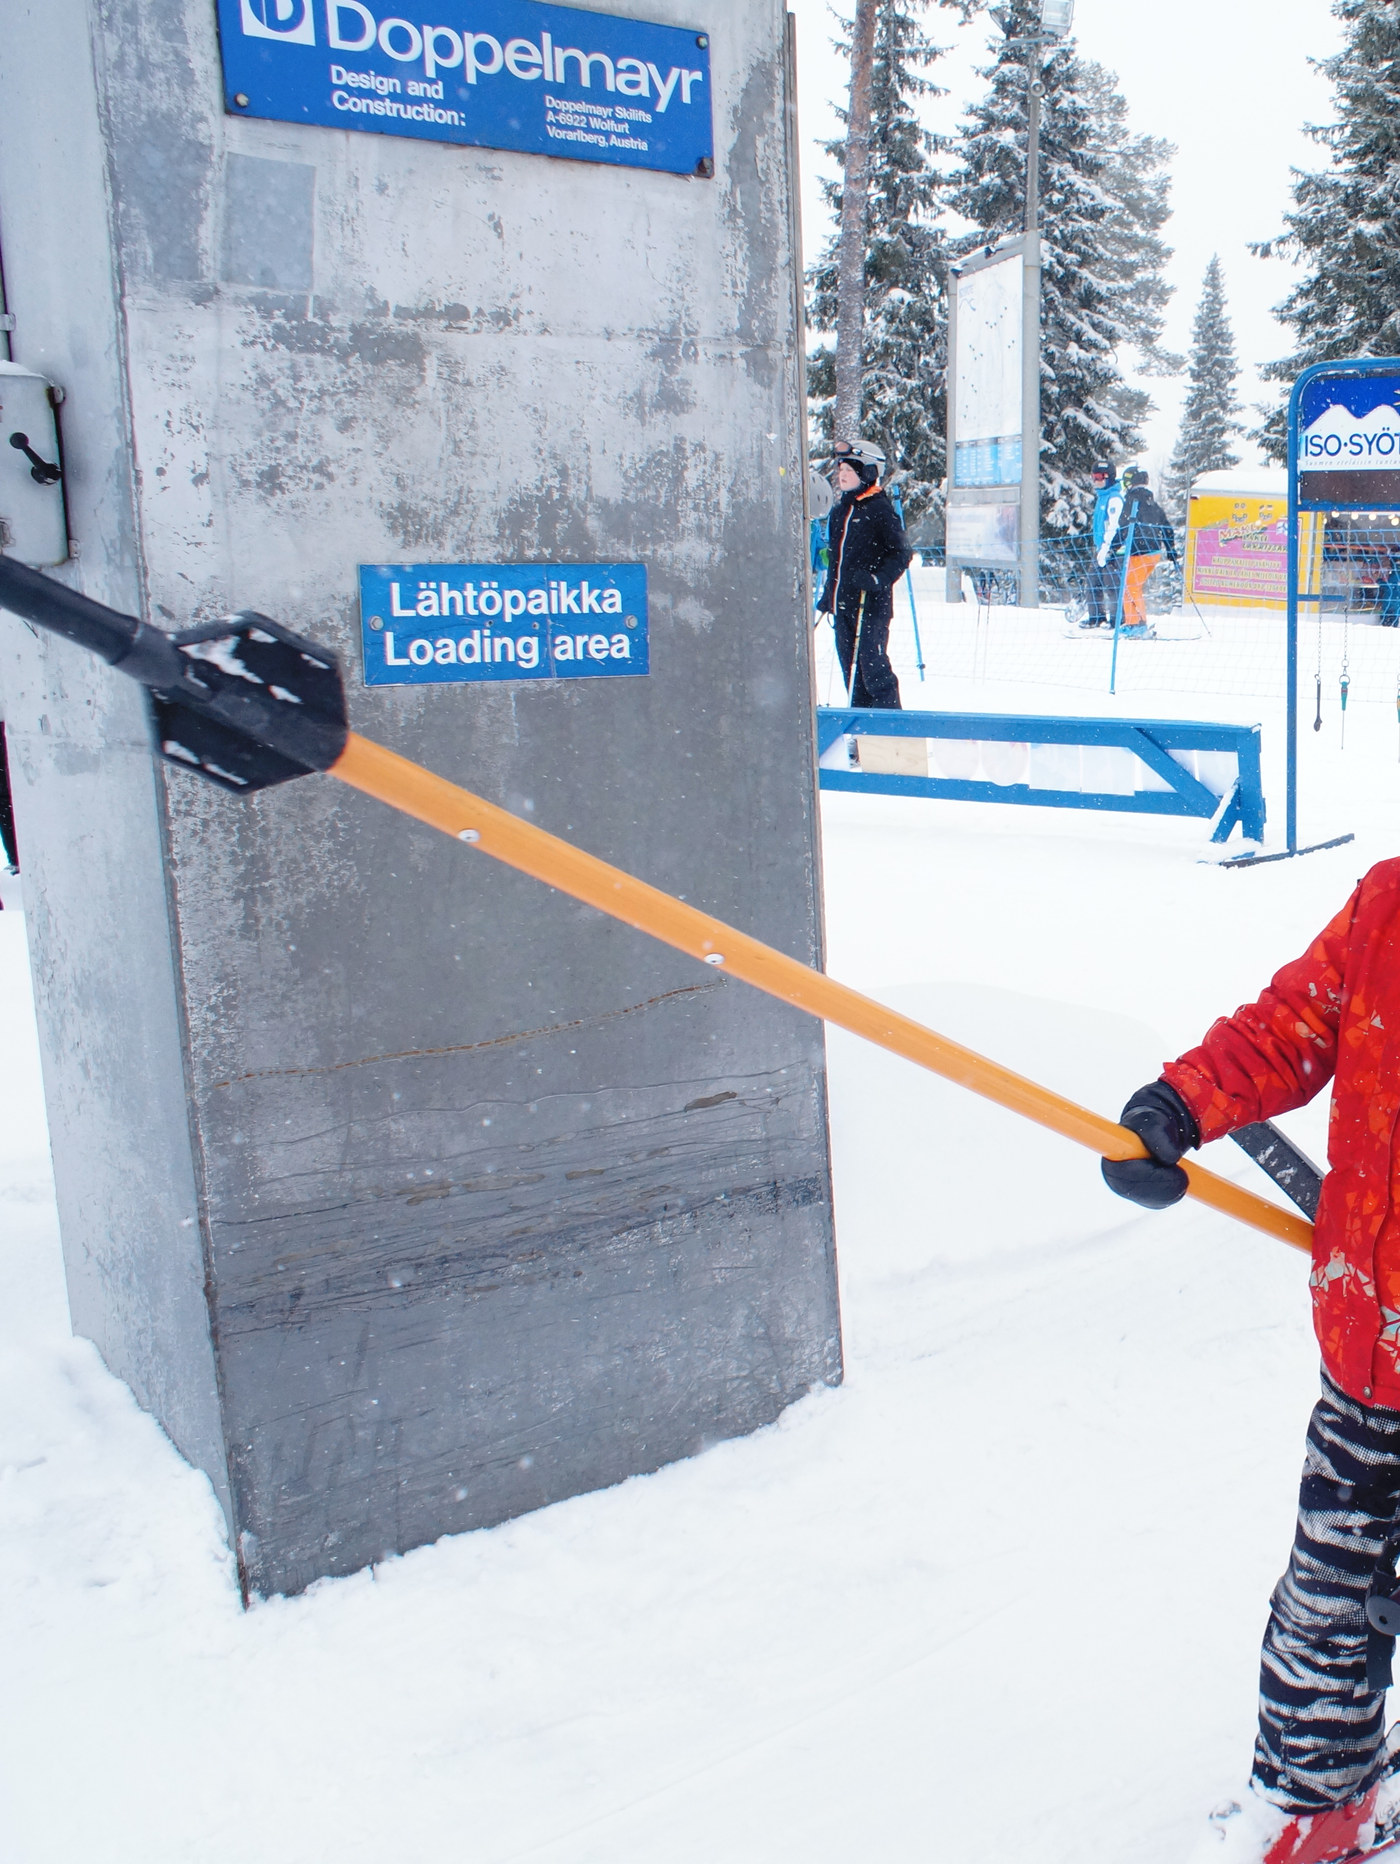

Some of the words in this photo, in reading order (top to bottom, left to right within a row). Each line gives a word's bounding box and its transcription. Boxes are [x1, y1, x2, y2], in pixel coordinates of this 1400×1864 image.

[326, 0, 703, 113] Doppelmayr
[330, 64, 401, 96] Design
[407, 80, 444, 100] and
[332, 90, 466, 127] Construction:
[545, 95, 613, 119] Doppelmayr
[614, 105, 652, 124] Skilifts
[546, 110, 588, 128] A-6922
[589, 116, 630, 134] Wolfurt
[546, 125, 608, 148] Vorarlberg,
[609, 135, 648, 151] Austria
[390, 580, 623, 622] Lähtöpaikka
[385, 629, 539, 668] Loading
[554, 632, 631, 661] area
